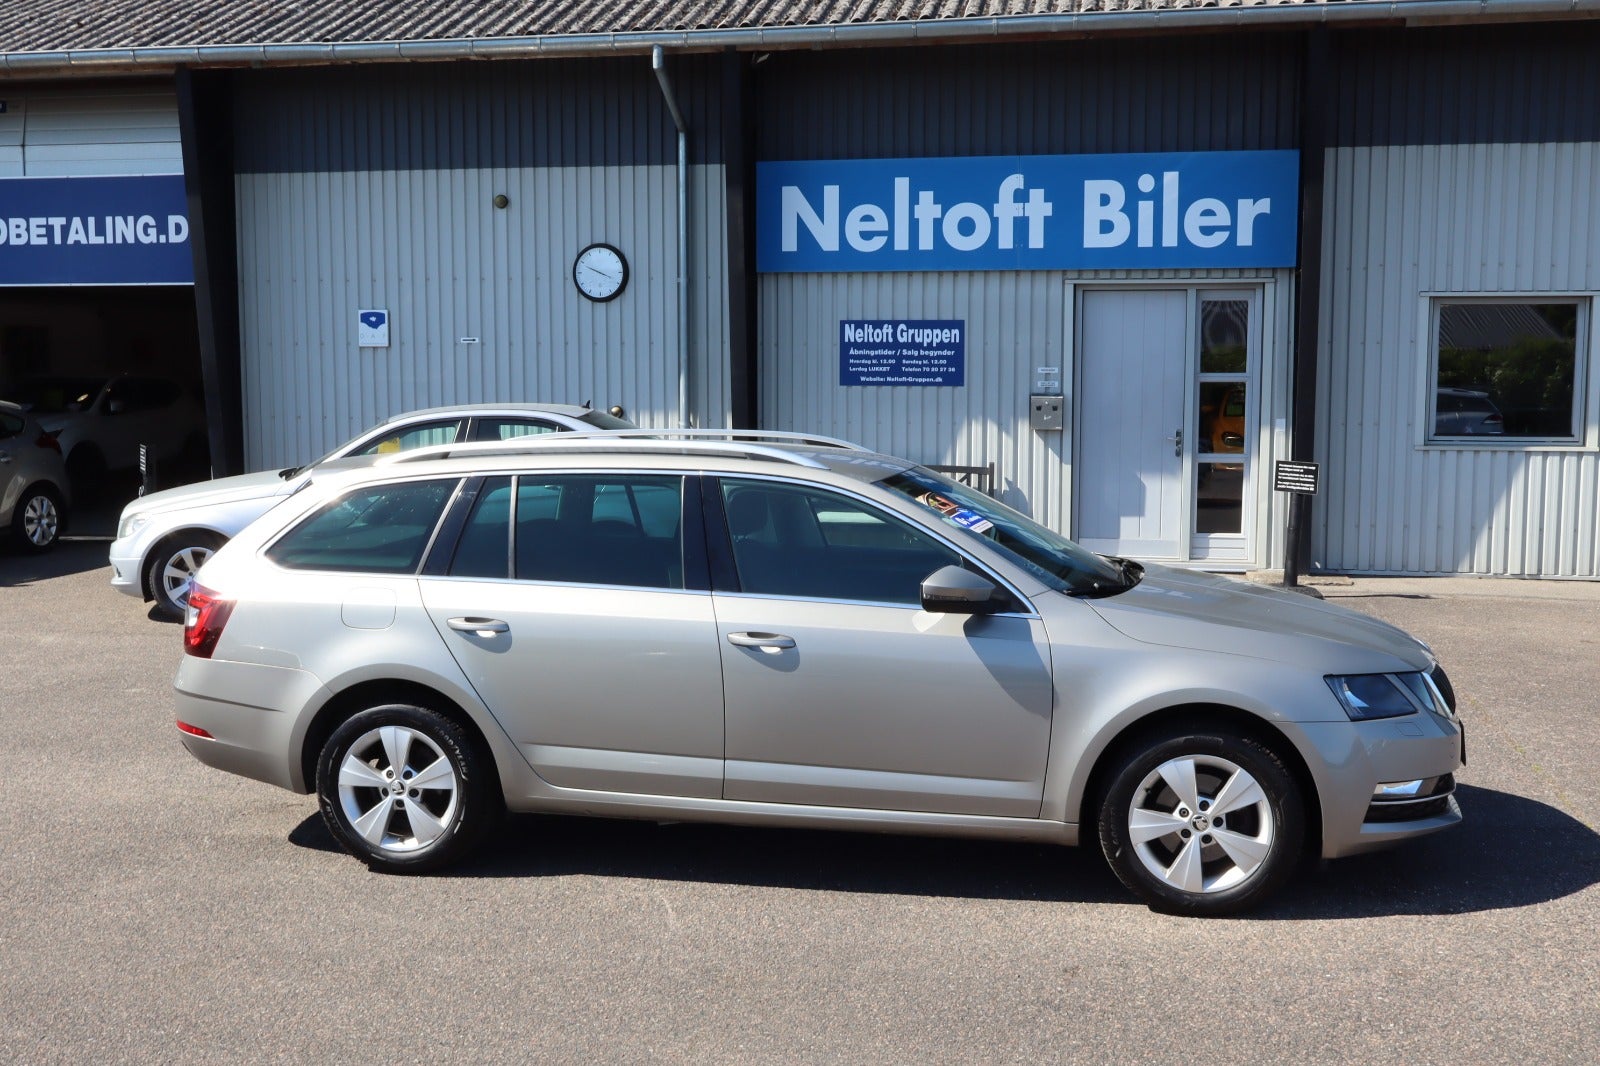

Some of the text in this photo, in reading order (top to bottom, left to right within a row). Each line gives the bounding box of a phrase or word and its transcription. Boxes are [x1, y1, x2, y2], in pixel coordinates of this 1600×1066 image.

[781, 171, 1271, 252] Neltoft Biler
[844, 323, 960, 347] Neltoft Gruppen
[849, 347, 895, 356] Åbningstider
